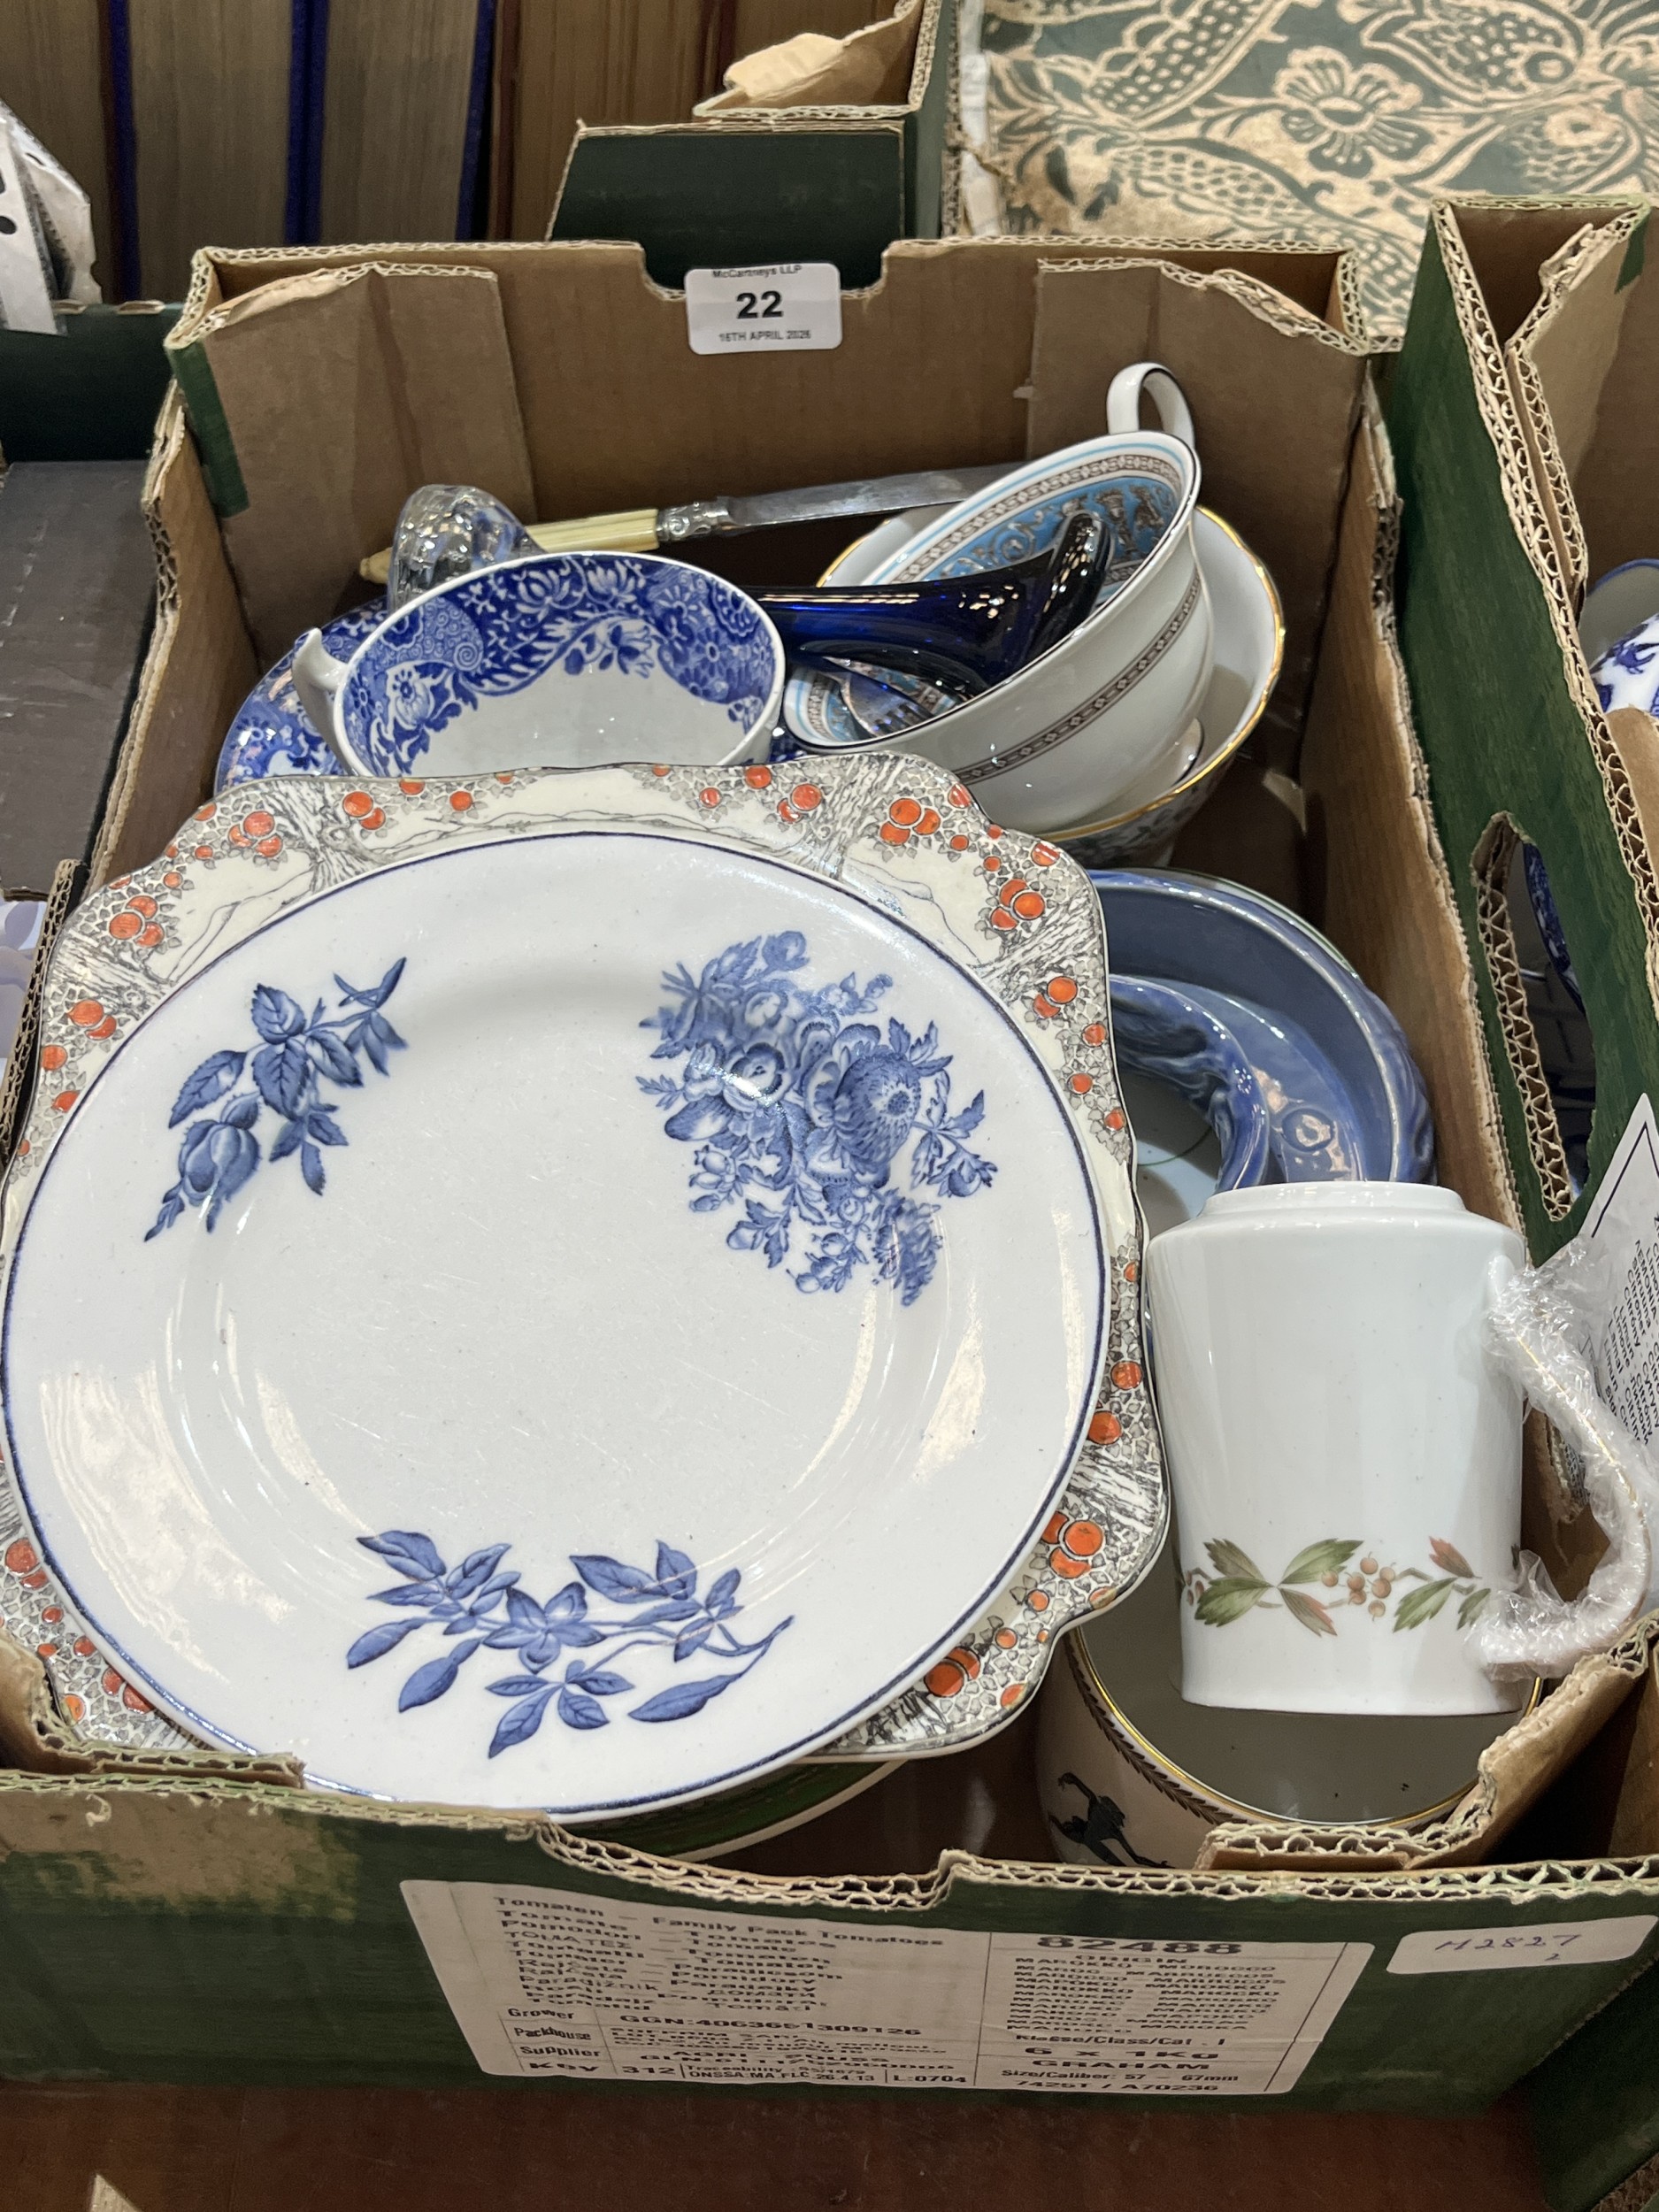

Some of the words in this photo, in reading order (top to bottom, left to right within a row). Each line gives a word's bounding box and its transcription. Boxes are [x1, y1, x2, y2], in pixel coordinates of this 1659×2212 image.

[711, 266, 778, 279] McCartneys
[780, 264, 803, 274] LLP
[736, 290, 784, 319] 22
[750, 330, 784, 341] APRIL
[1628, 1270, 1646, 1335] Citroner
[1614, 1306, 1630, 1367] Limone
[1619, 1306, 1634, 1359] Limun
[652, 1916, 737, 1932] Family
[748, 1925, 807, 1937] Pack
[817, 1931, 943, 1947] Tomatoes
[1037, 1937, 1242, 1955] 82488
[1075, 1955, 1187, 1964] ORIGIN
[507, 2008, 575, 2019] Grower
[513, 2026, 592, 2040] Packhouse
[519, 2046, 602, 2057] Supplier
[1025, 2047, 1053, 2055] 6
[529, 2062, 600, 2072] Key
[621, 2066, 676, 2075] 312
[686, 2064, 783, 2073] Traceability
[1032, 2060, 1210, 2070] GRAHAM
[1001, 2070, 1118, 2080] Size/Caliber:
